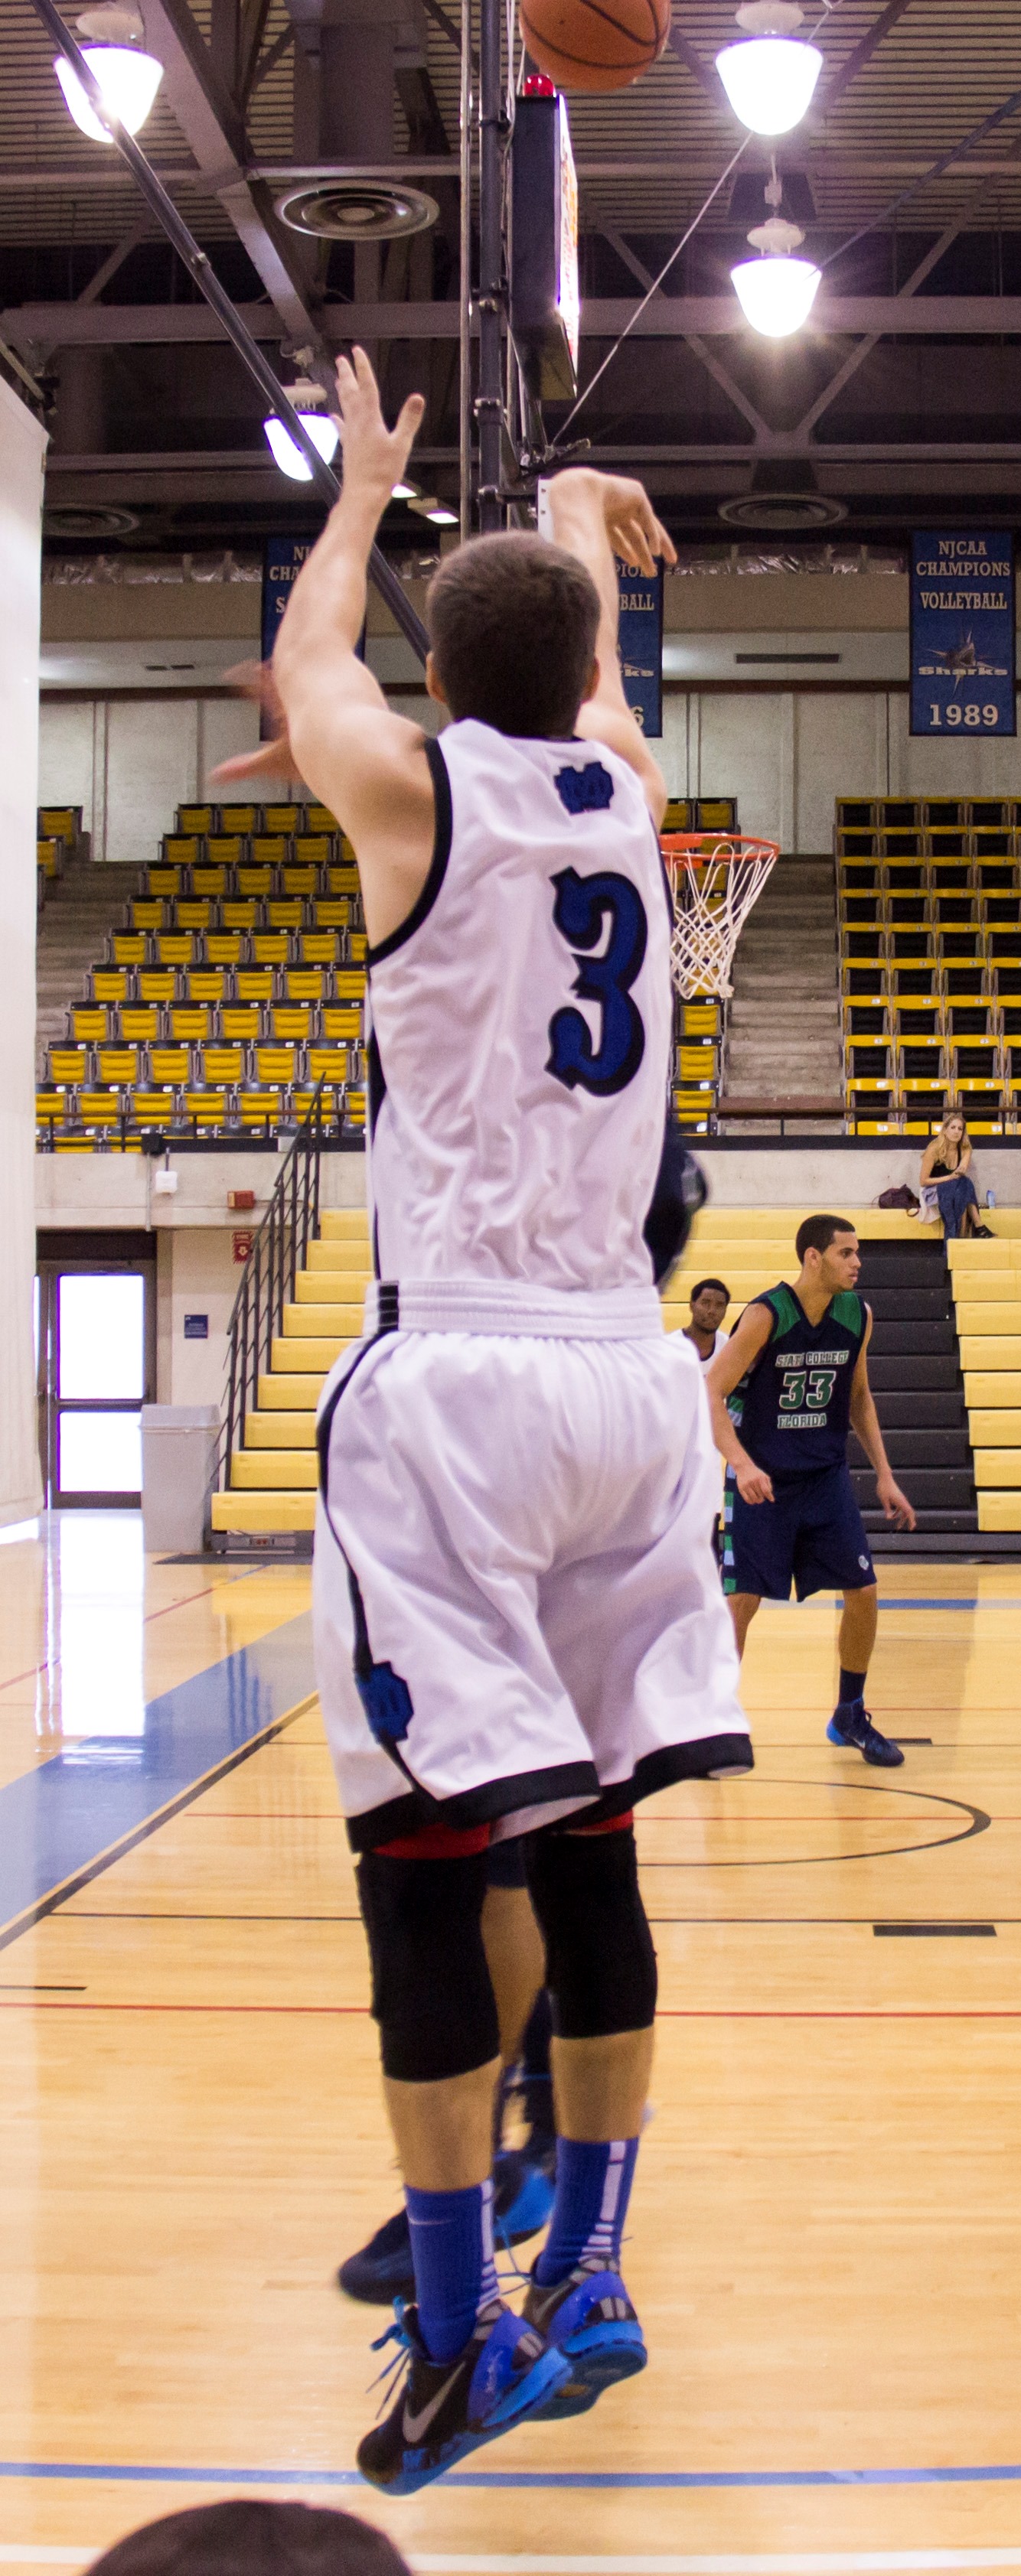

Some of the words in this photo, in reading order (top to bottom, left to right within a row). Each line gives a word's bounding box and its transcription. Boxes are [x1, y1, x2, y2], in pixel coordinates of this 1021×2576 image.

[938, 541, 987, 558] NJCAA
[916, 562, 1010, 576] CHAMPIONS
[920, 592, 1007, 609] VOLLEYBALL
[918, 666, 1009, 676] Sharks
[930, 705, 999, 726] 1989
[544, 866, 648, 1097] 3
[806, 1350, 850, 1366] COLLEGE
[779, 1371, 837, 1409] 33
[777, 1413, 827, 1429] FLORIDA
